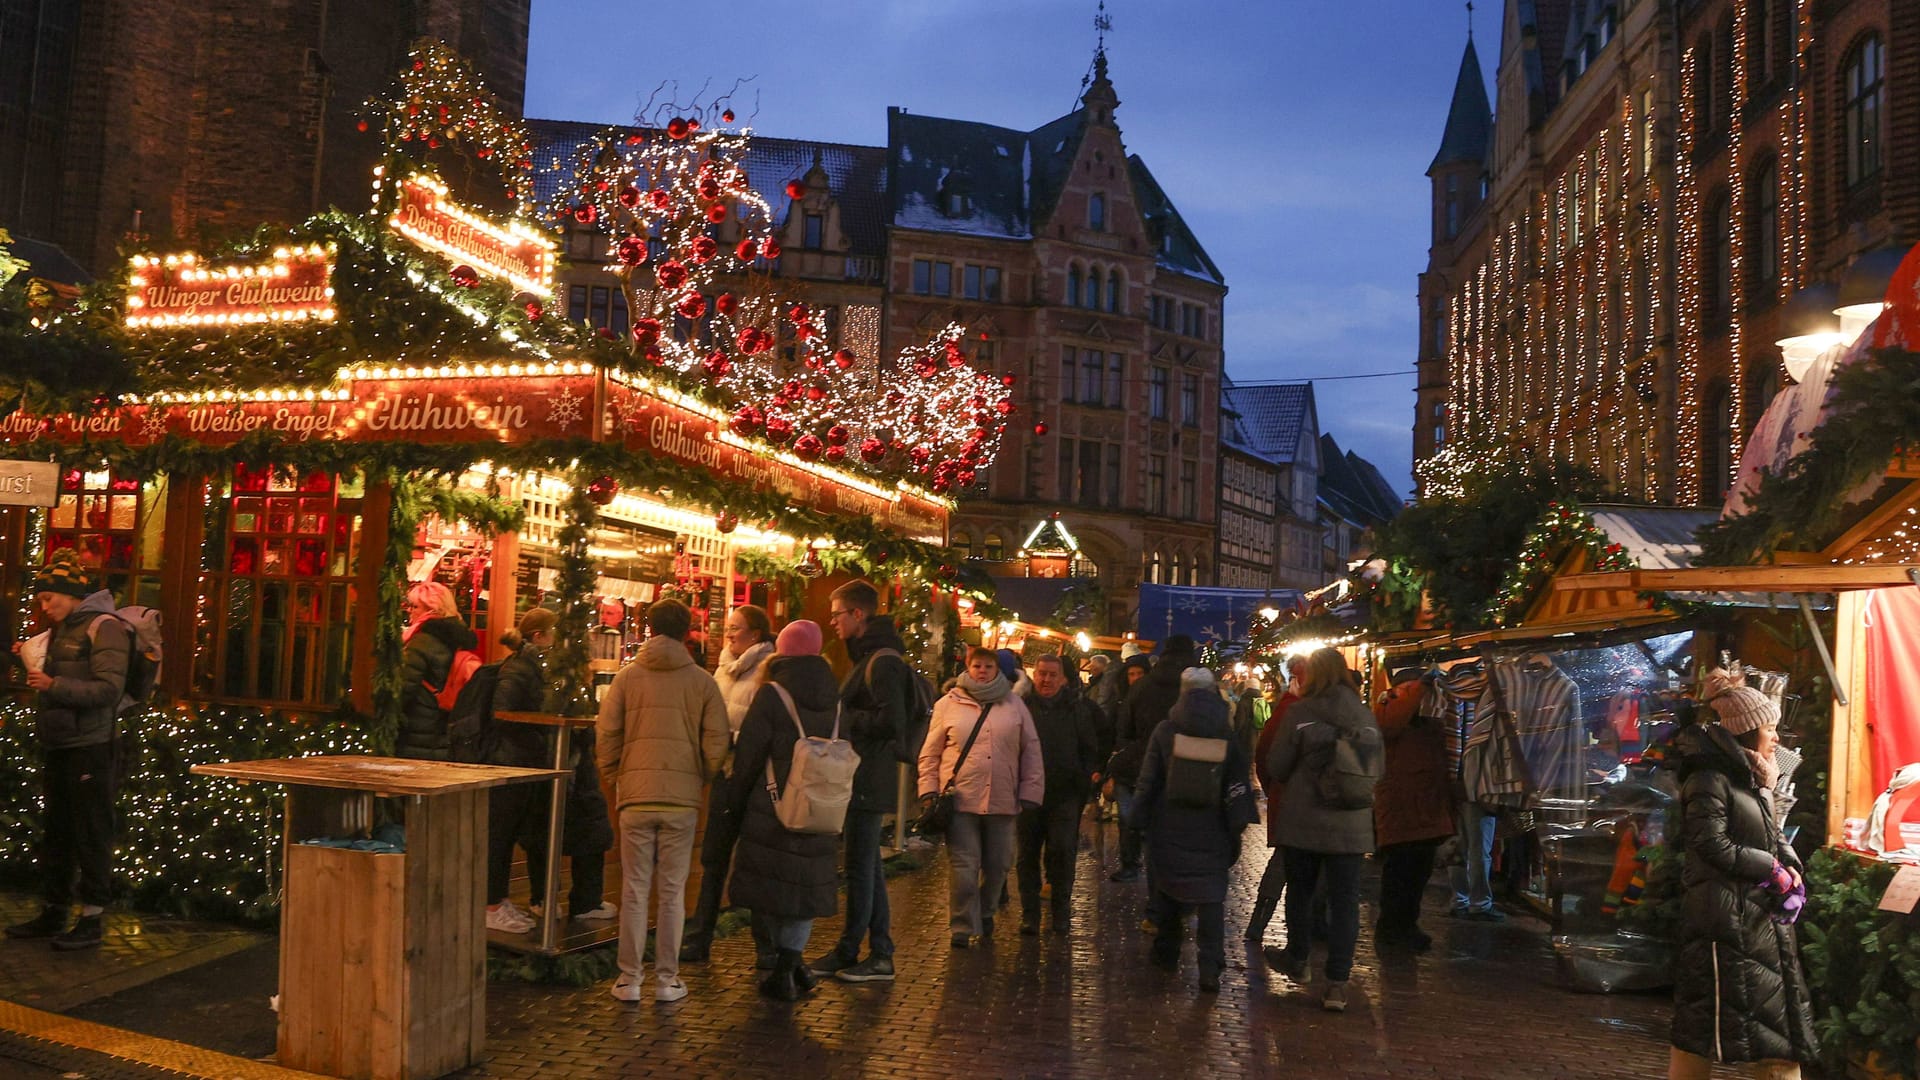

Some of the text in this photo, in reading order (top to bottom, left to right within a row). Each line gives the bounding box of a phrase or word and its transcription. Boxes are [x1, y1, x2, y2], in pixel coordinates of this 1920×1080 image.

[406, 203, 530, 276] Doris Glühweinhütte
[147, 286, 220, 315] Winzer
[187, 404, 337, 442] Weißer Engel
[366, 392, 528, 431] Glühwein
[650, 415, 722, 470] Glühwein
[732, 453, 793, 491] Winzer Wein
